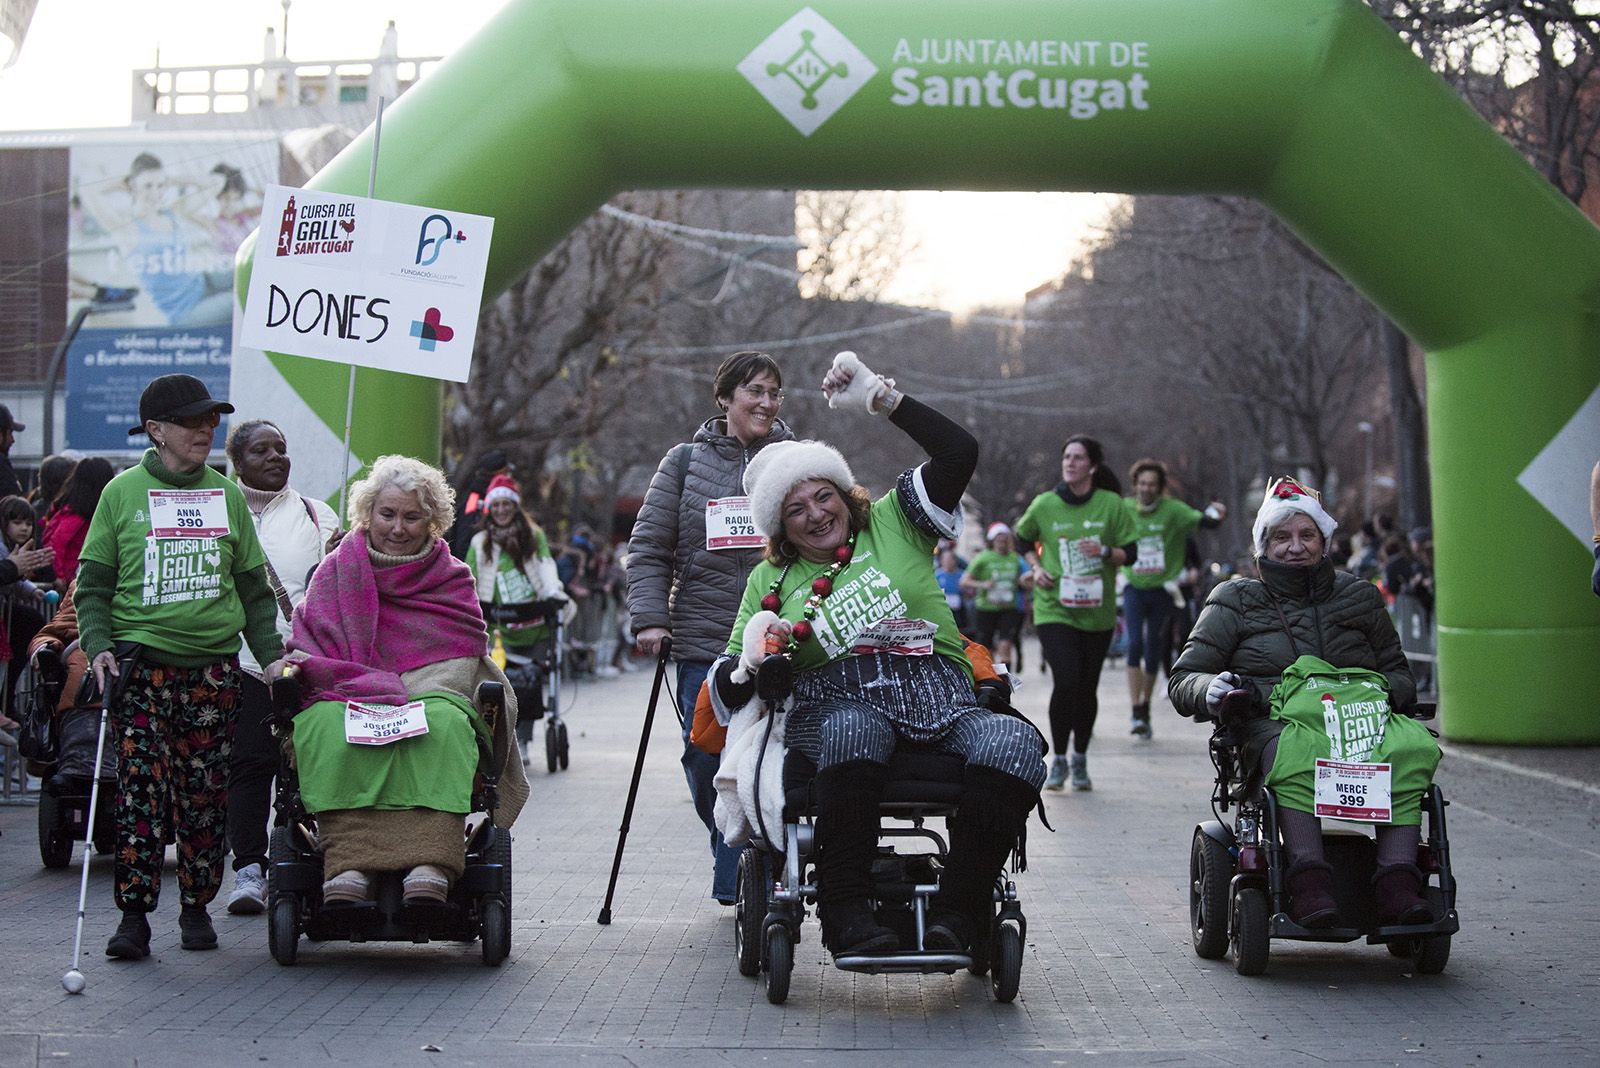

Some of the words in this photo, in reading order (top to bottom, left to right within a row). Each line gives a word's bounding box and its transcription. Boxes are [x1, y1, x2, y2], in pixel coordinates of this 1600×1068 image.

[893, 38, 1101, 67] AJUNTAMENT
[1111, 42, 1149, 68] DE
[890, 67, 1149, 119] SantCugat
[301, 204, 336, 219] CURSA
[338, 203, 355, 217] DEL
[297, 220, 338, 241] GALL
[294, 242, 320, 255] SANT
[321, 240, 354, 253] CUGAT
[266, 284, 390, 343] DONES
[177, 509, 201, 517] ANNA
[178, 518, 203, 527] 390
[730, 525, 755, 535] 378
[164, 539, 199, 556] CURSA
[201, 539, 220, 551] DEL
[162, 554, 206, 580] GALL
[161, 578, 188, 594] SANT
[190, 574, 221, 591] CUGAT
[824, 580, 861, 610] CURSA
[859, 566, 881, 585] DEL
[830, 585, 881, 630] GALL
[841, 613, 869, 644] SANT
[868, 588, 902, 622] CUGAT
[859, 633, 891, 642] MARIA
[1341, 701, 1376, 718] CURSA
[363, 718, 409, 731] JOSEFINA
[1336, 783, 1367, 795] MERCE
[1340, 795, 1365, 807] 399
